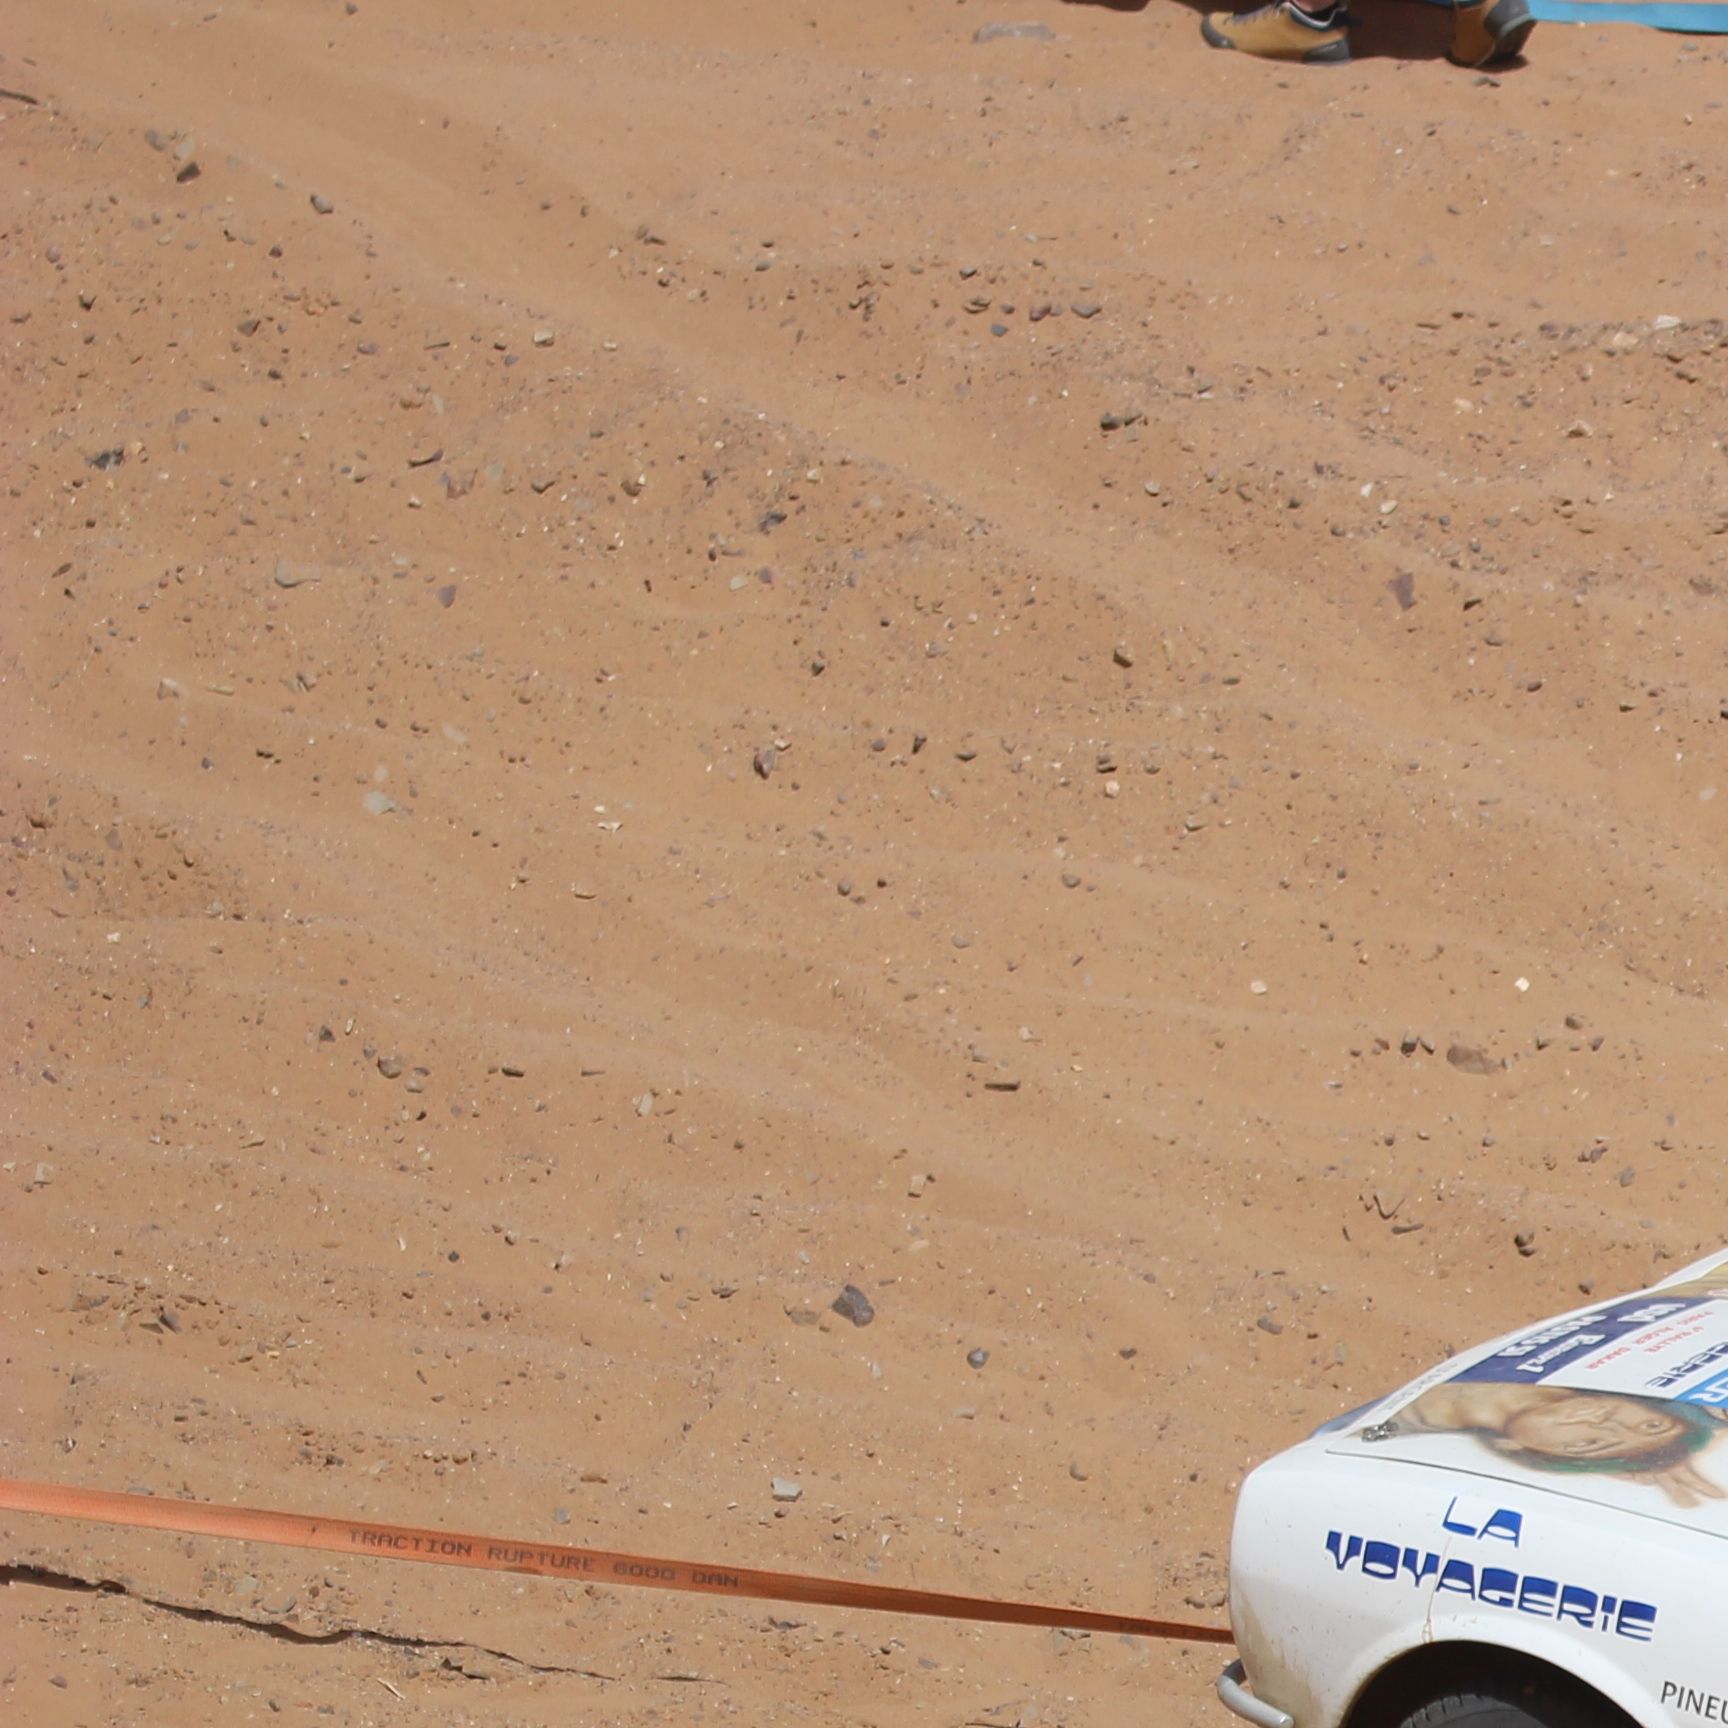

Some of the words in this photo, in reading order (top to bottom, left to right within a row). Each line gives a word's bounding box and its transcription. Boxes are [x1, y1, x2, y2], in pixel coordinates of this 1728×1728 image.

[1442, 1495, 1524, 1548] LA
[347, 1528, 472, 1558] TRACTION
[487, 1547, 595, 1573] RUPTURE
[1326, 1530, 1658, 1642] VOYAGERIE
